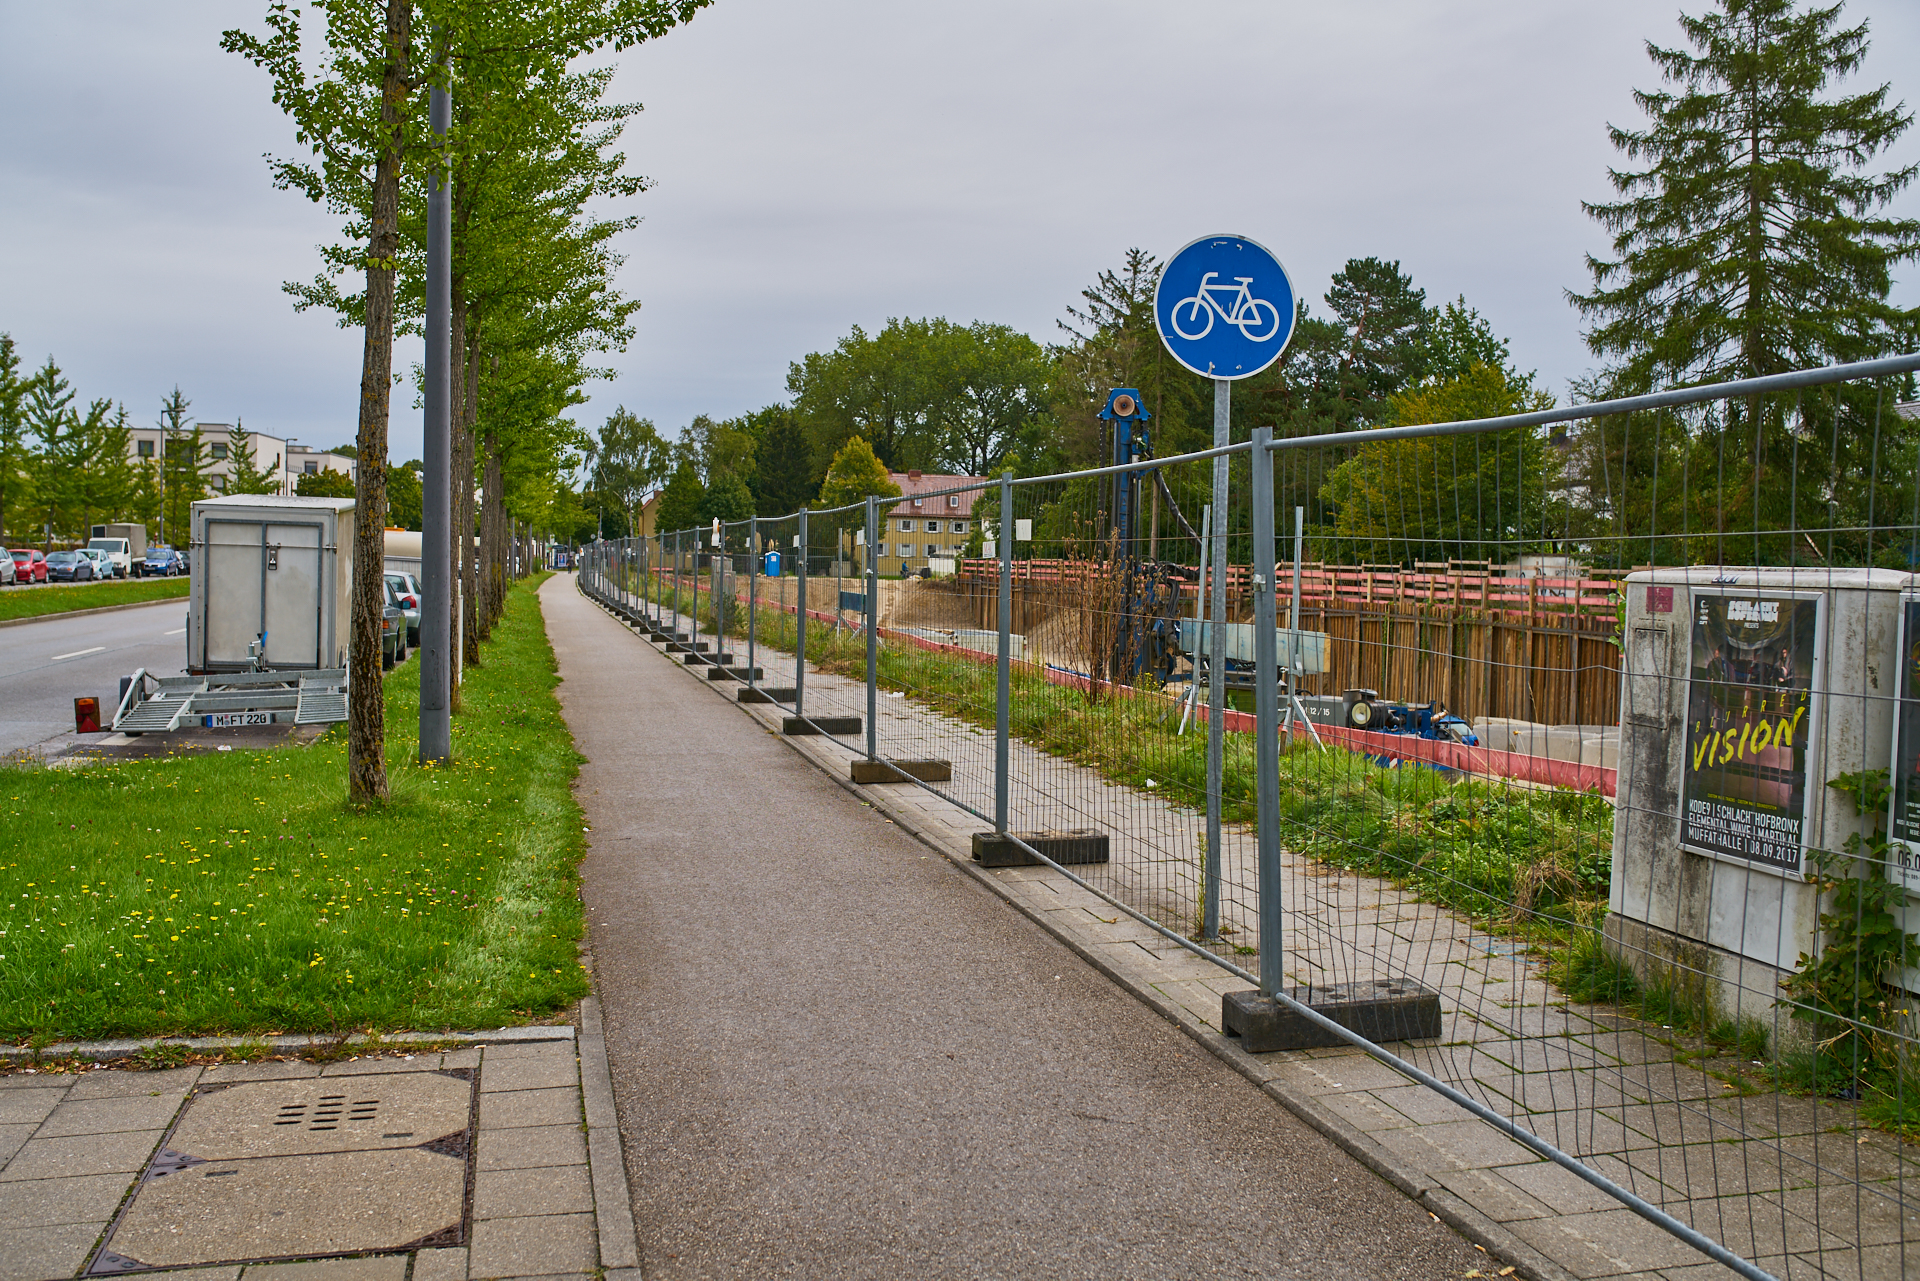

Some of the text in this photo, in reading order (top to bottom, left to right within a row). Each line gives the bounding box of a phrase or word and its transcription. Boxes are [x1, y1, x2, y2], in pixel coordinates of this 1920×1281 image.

[217, 716, 223, 725] M
[230, 714, 244, 725] FT
[1695, 688, 1808, 733] BLURRED
[1693, 706, 1806, 772] VISION
[1689, 799, 1710, 815] KODE9
[1689, 812, 1728, 834] ELEMENTAL
[1730, 822, 1751, 839] WAVE
[1689, 826, 1742, 850] MUFFATHALLE
[1750, 840, 1798, 863] 08.09.2017
